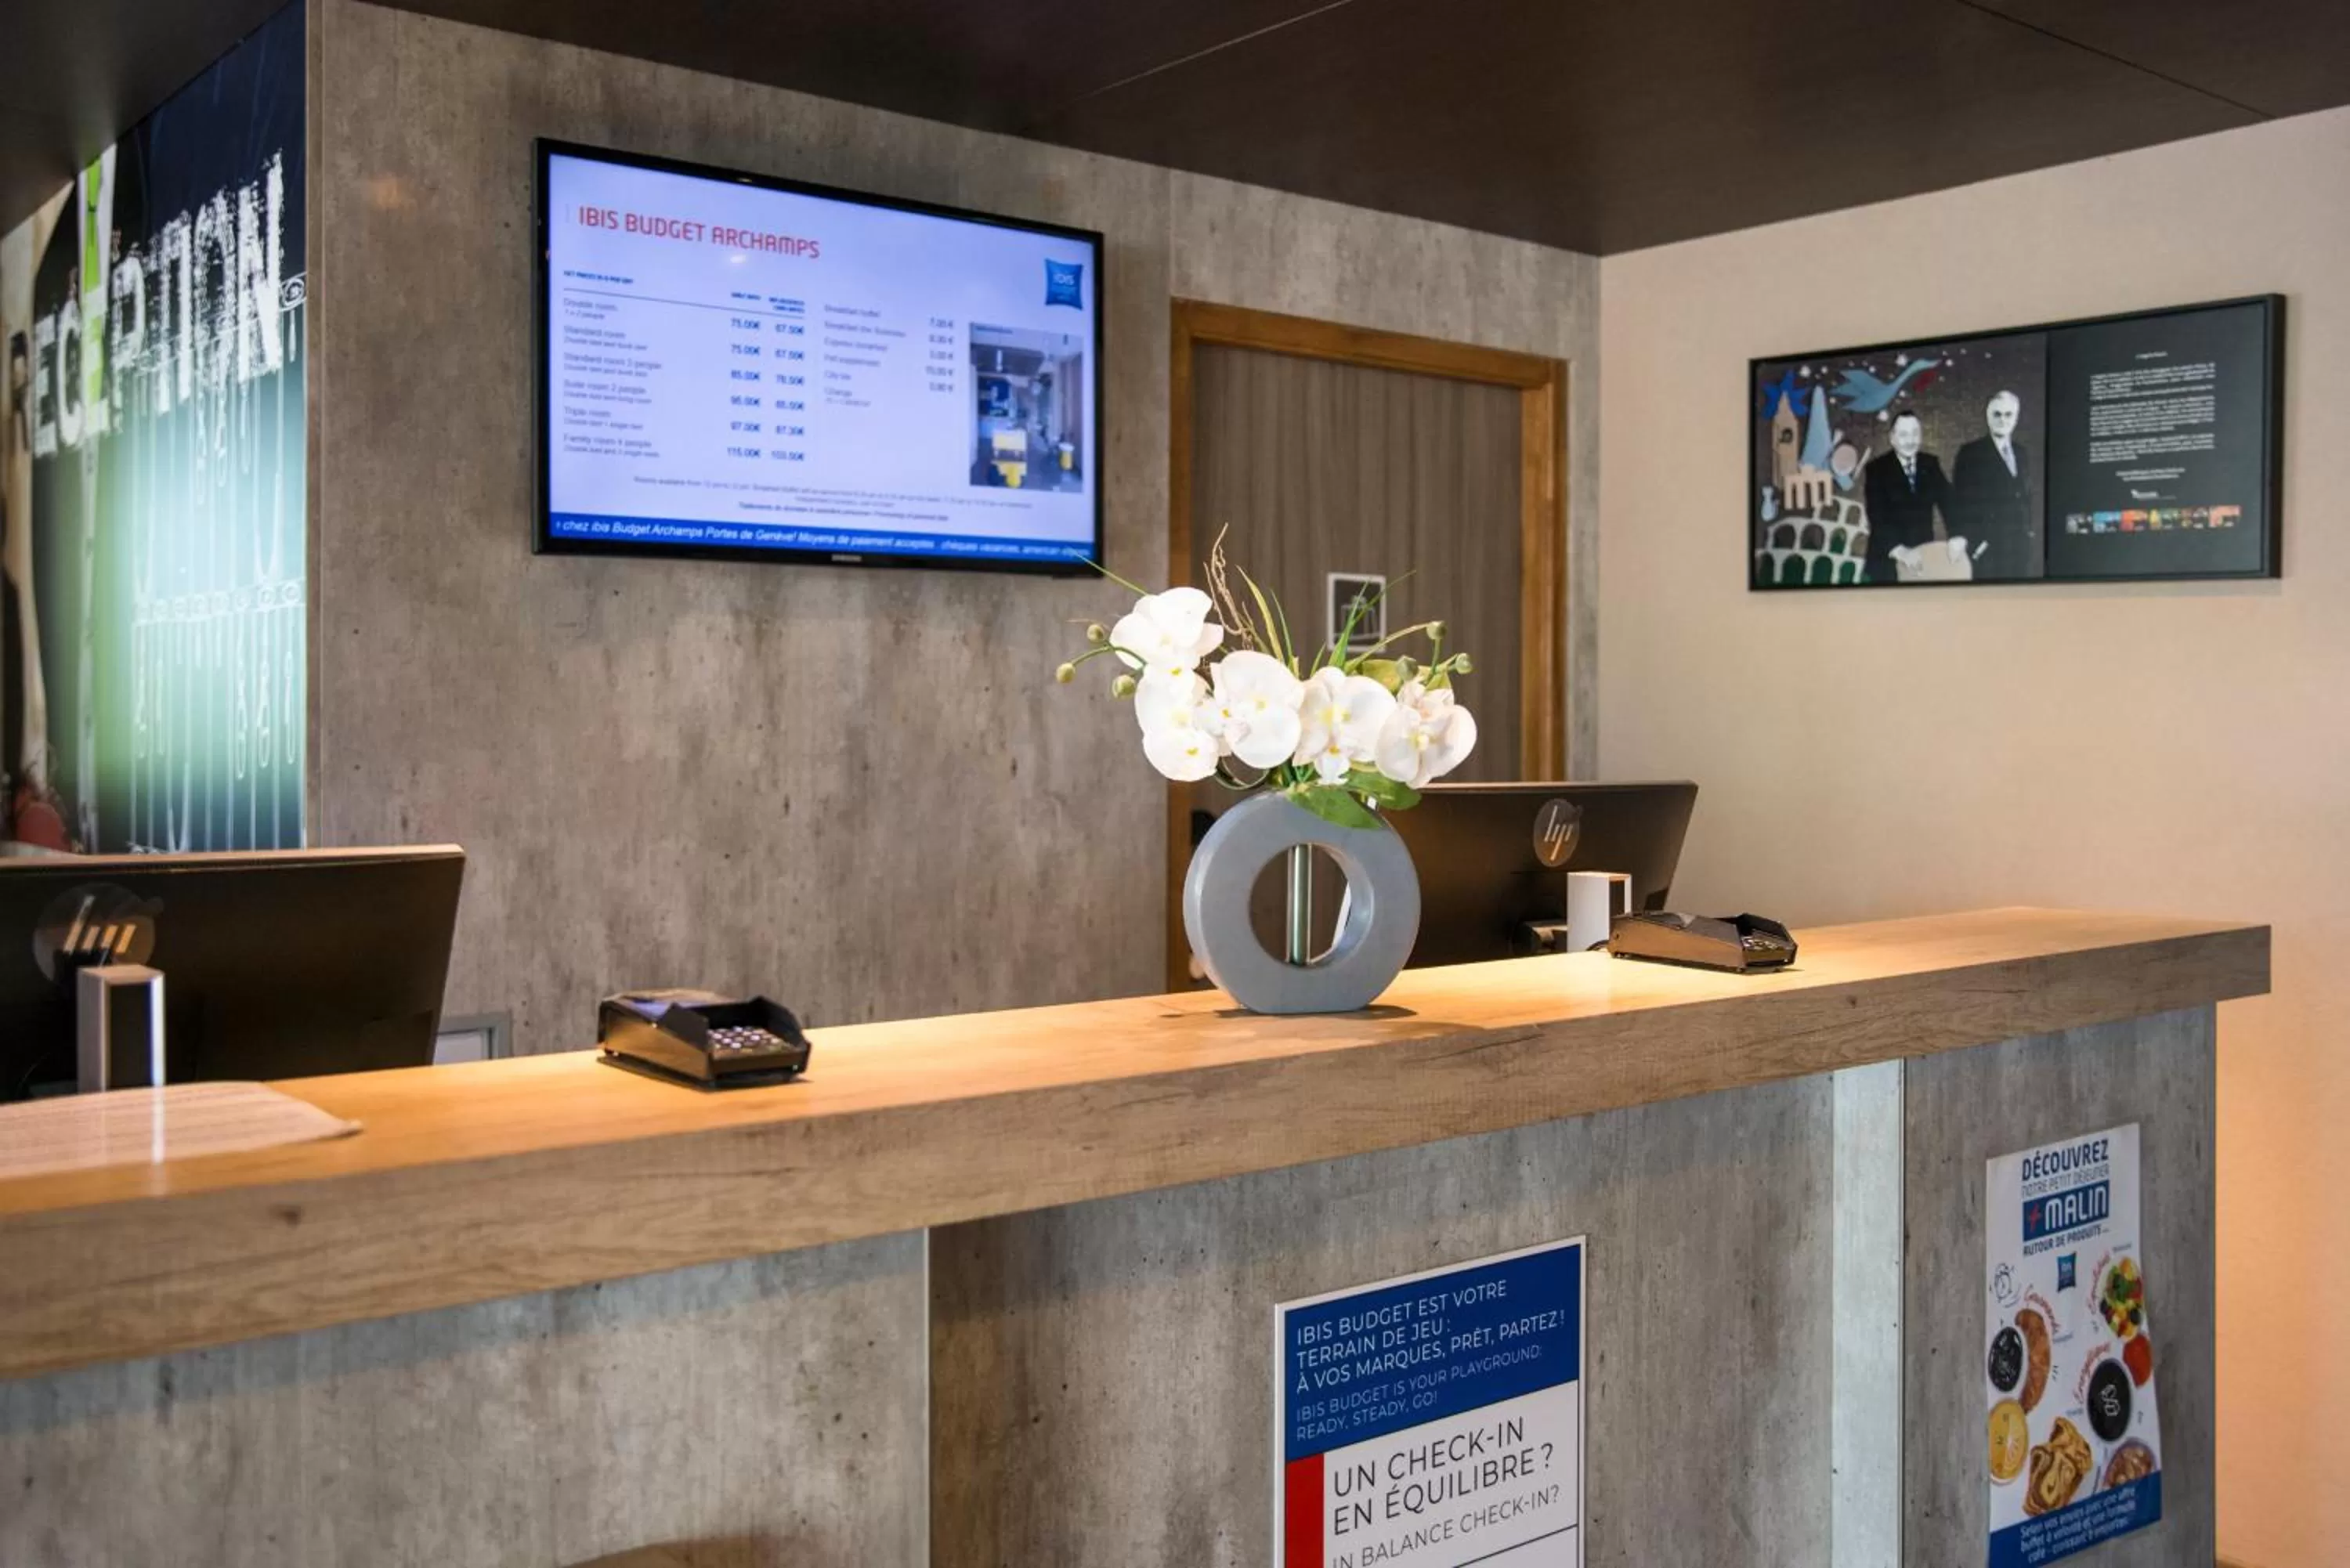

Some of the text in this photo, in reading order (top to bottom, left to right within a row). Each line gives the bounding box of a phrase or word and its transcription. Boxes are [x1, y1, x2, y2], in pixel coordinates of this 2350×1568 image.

[578, 205, 820, 259] IBIS BUDGET ARCHAMPS
[562, 520, 589, 533] chez
[612, 521, 650, 537] Budget
[651, 524, 703, 540] Archamps
[705, 526, 739, 540] Portes
[739, 528, 754, 540] de
[1544, 805, 1573, 862] hp
[2022, 1138, 2110, 1181] DÉCOUVREZ
[2045, 1185, 2107, 1231] MALIN
[2023, 1237, 2054, 1257] AUTOUR
[2055, 1234, 2066, 1248] DE
[1297, 1279, 1507, 1346] IBIS BUDGET EST VOTRE
[1296, 1372, 1310, 1394] À
[1314, 1364, 1351, 1389] VOS
[1356, 1340, 1446, 1378] MARQUES,
[1451, 1327, 1495, 1353] PRÊT,
[1297, 1334, 1376, 1370] TERRAIN
[1383, 1327, 1406, 1348] DE
[1297, 1345, 1542, 1422] IBIS BUDGET IS YOUR PLAYGROUND:
[1297, 1391, 1437, 1441] READY, STEADY, GO!
[1334, 1416, 1524, 1498] UN CHECK-IN
[1334, 1498, 1372, 1536] EN
[1386, 1447, 1535, 1519] ÉQUILIBRE
[1332, 1483, 1560, 1568] IN BALANCE CHECK-IN?
